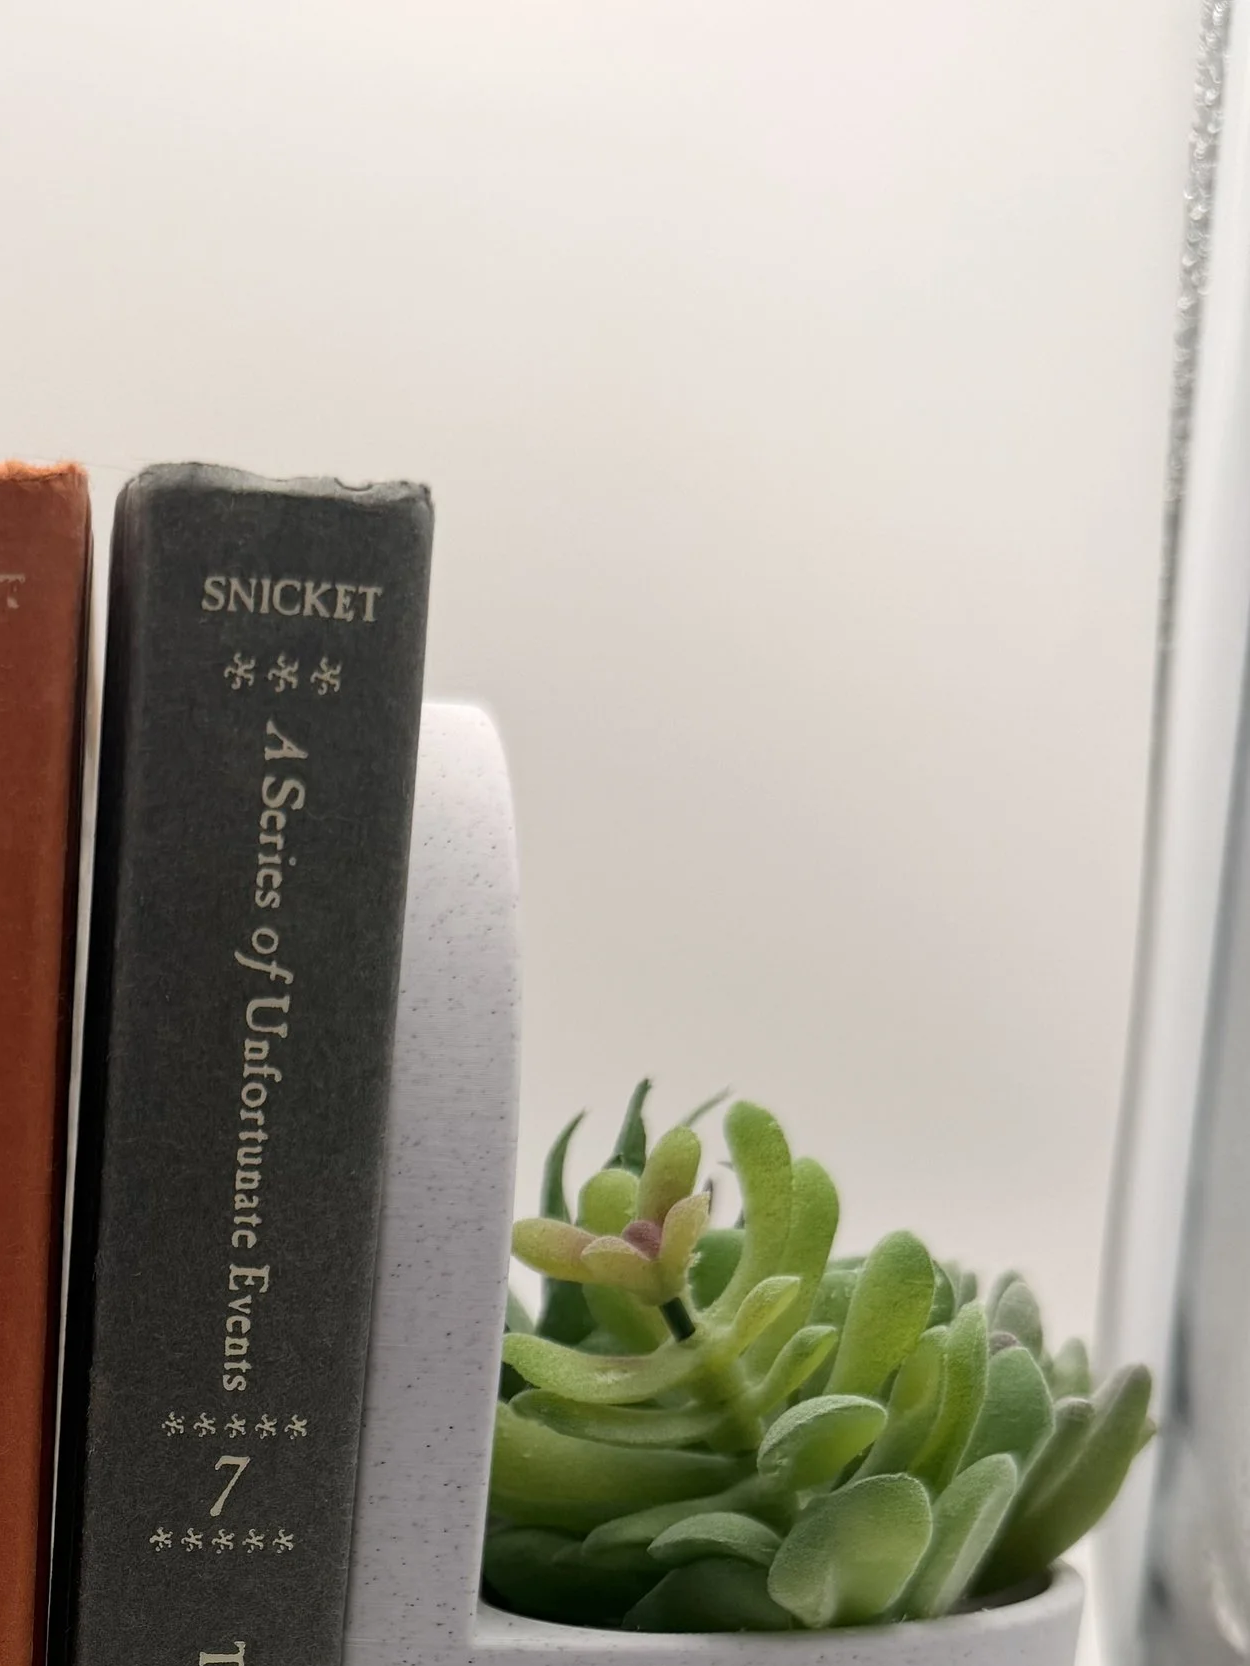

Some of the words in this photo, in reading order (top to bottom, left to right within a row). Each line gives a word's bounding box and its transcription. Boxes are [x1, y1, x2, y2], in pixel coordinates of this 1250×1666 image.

[201, 574, 383, 623] SNICKET
[264, 719, 309, 761] A
[254, 774, 306, 909] Series
[233, 925, 294, 985] of
[231, 994, 291, 1249] Unfortunate
[222, 1262, 271, 1392] Events
[209, 1454, 251, 1517] 7
